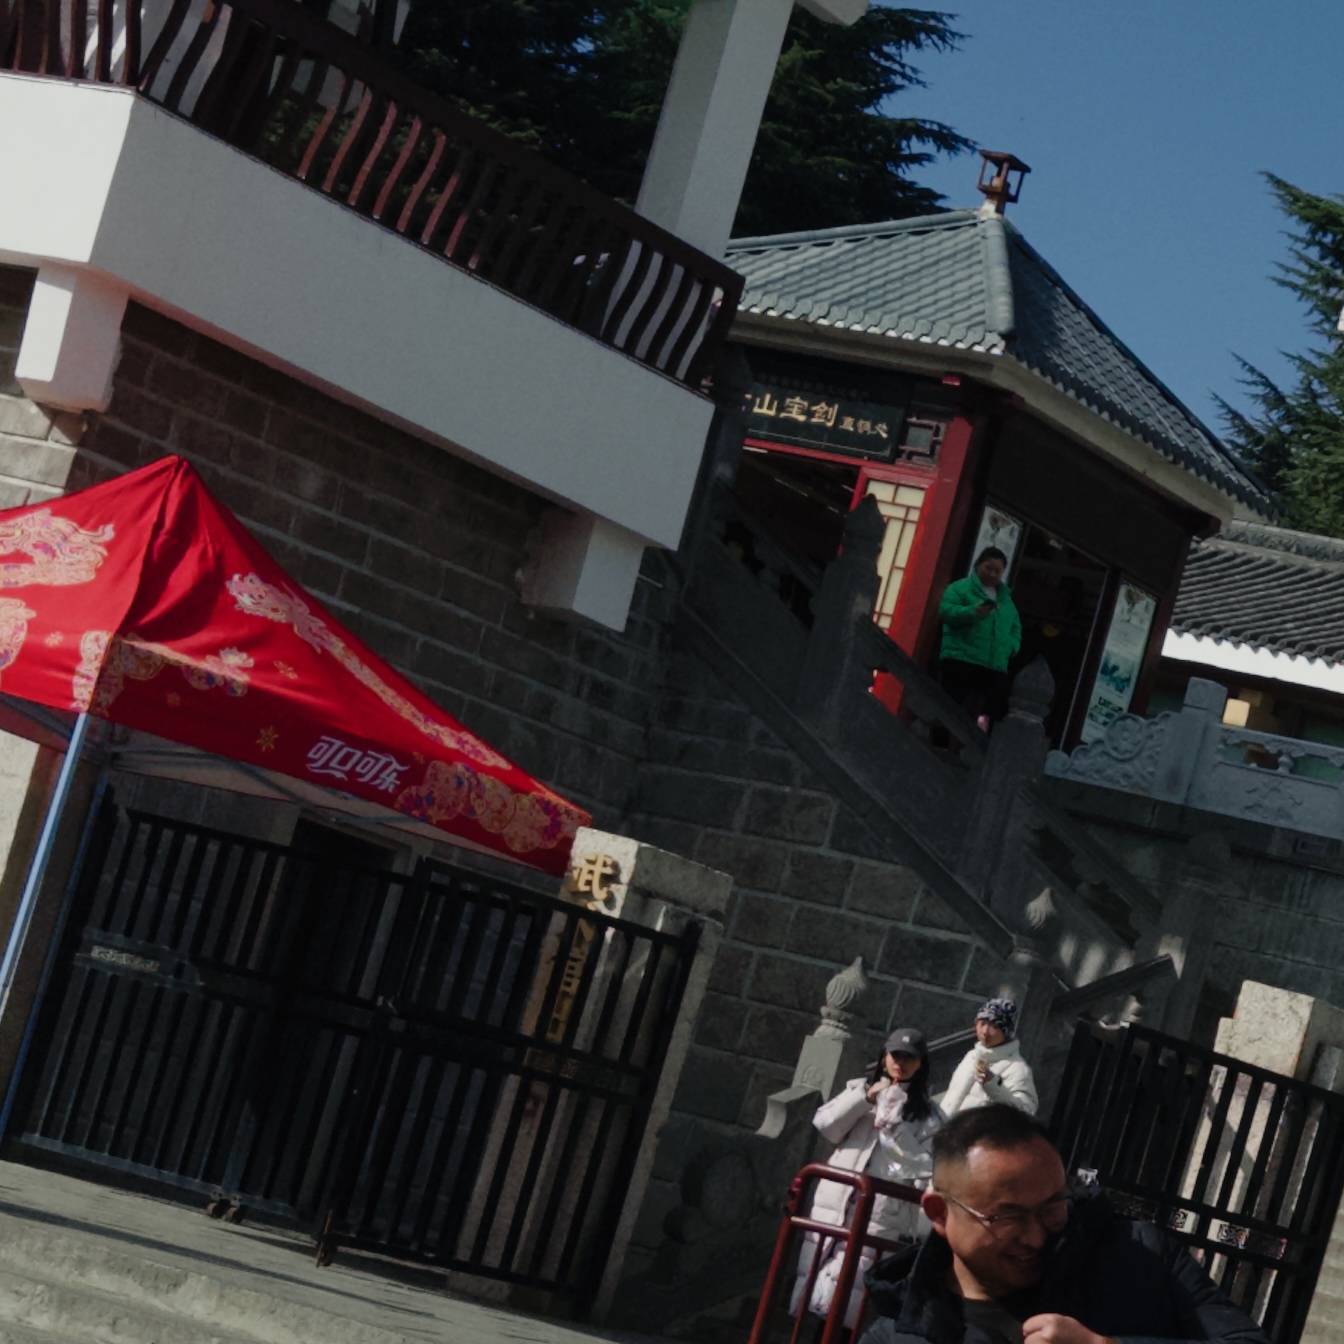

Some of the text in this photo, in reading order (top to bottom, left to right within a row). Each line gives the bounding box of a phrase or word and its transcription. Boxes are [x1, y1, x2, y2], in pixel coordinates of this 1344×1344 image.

[743, 393, 839, 427] 山宝剑
[305, 735, 409, 793] 可口可乐
